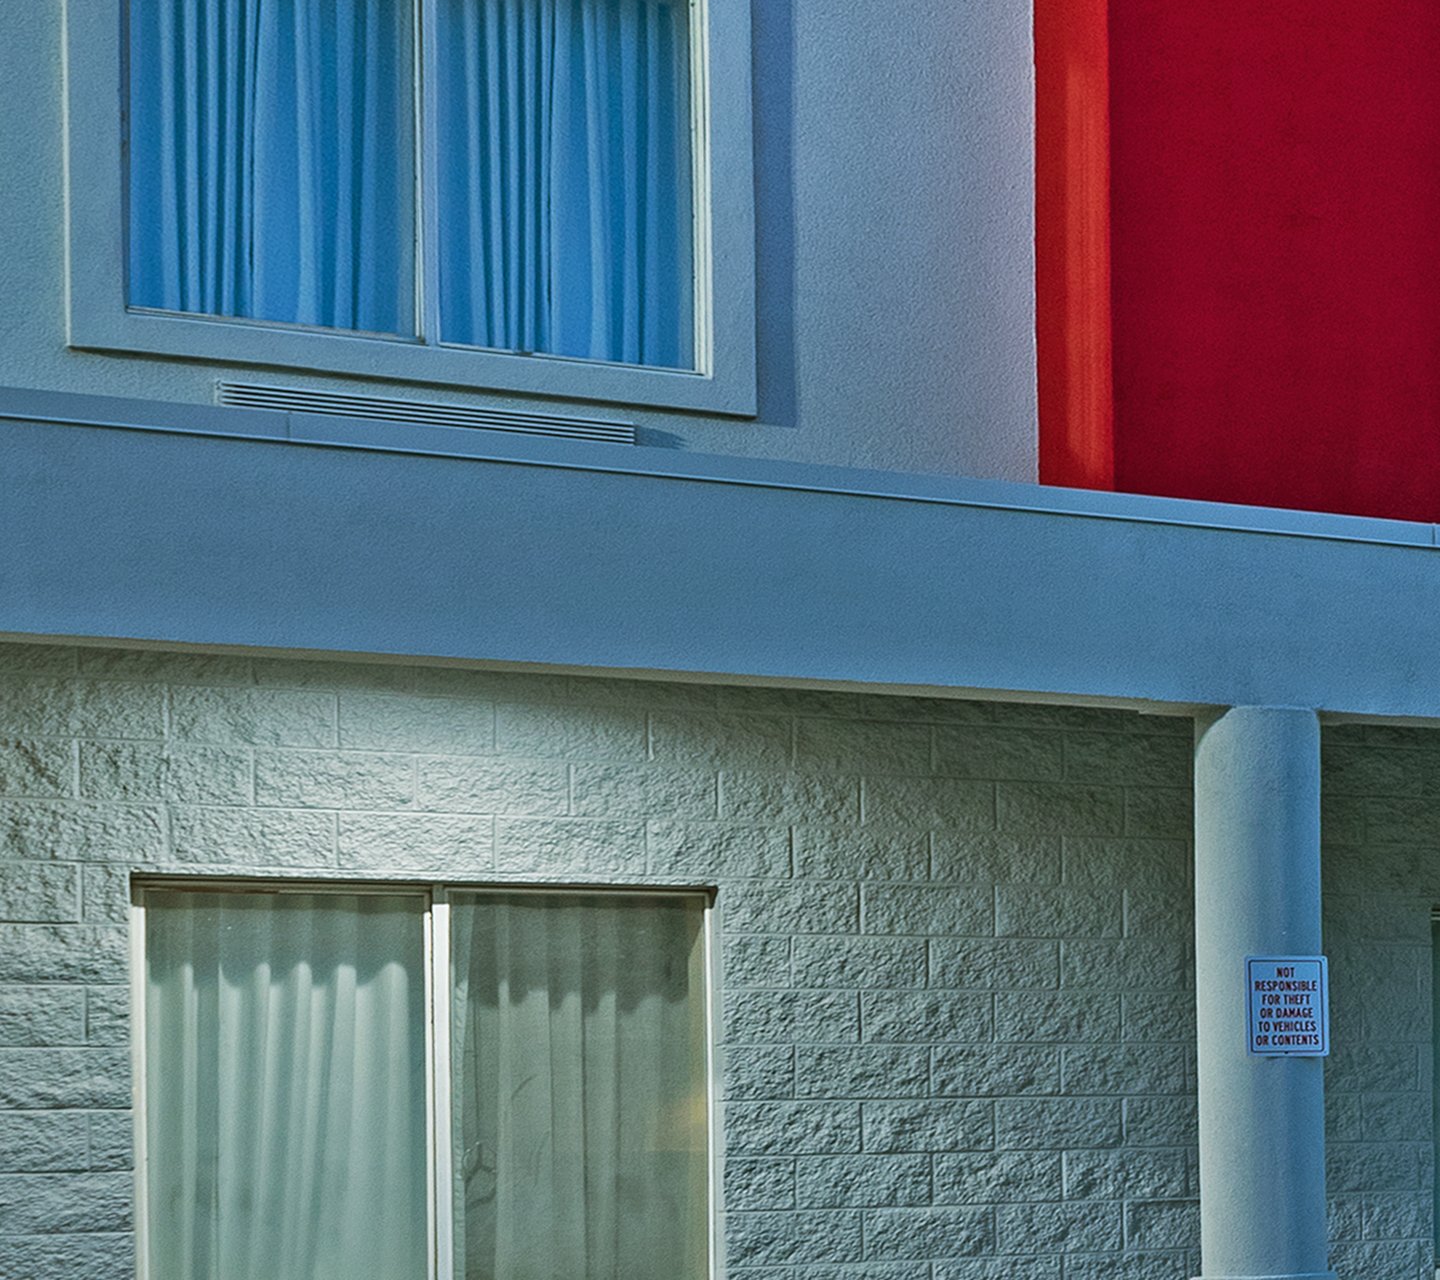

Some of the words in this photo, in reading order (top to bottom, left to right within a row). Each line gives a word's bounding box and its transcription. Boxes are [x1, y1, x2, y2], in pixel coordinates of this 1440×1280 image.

[1276, 967, 1295, 978] NOT
[1254, 980, 1317, 991] RESPONSIBLE
[1262, 994, 1280, 1005] FOR
[1283, 994, 1311, 1005] THEFT
[1260, 1007, 1273, 1018] OR
[1276, 1007, 1313, 1018] DAMAGE
[1258, 1021, 1270, 1032] TO
[1272, 1021, 1317, 1032] VEHICLES
[1255, 1035, 1269, 1046] OR
[1272, 1034, 1319, 1045] CONTENTS
